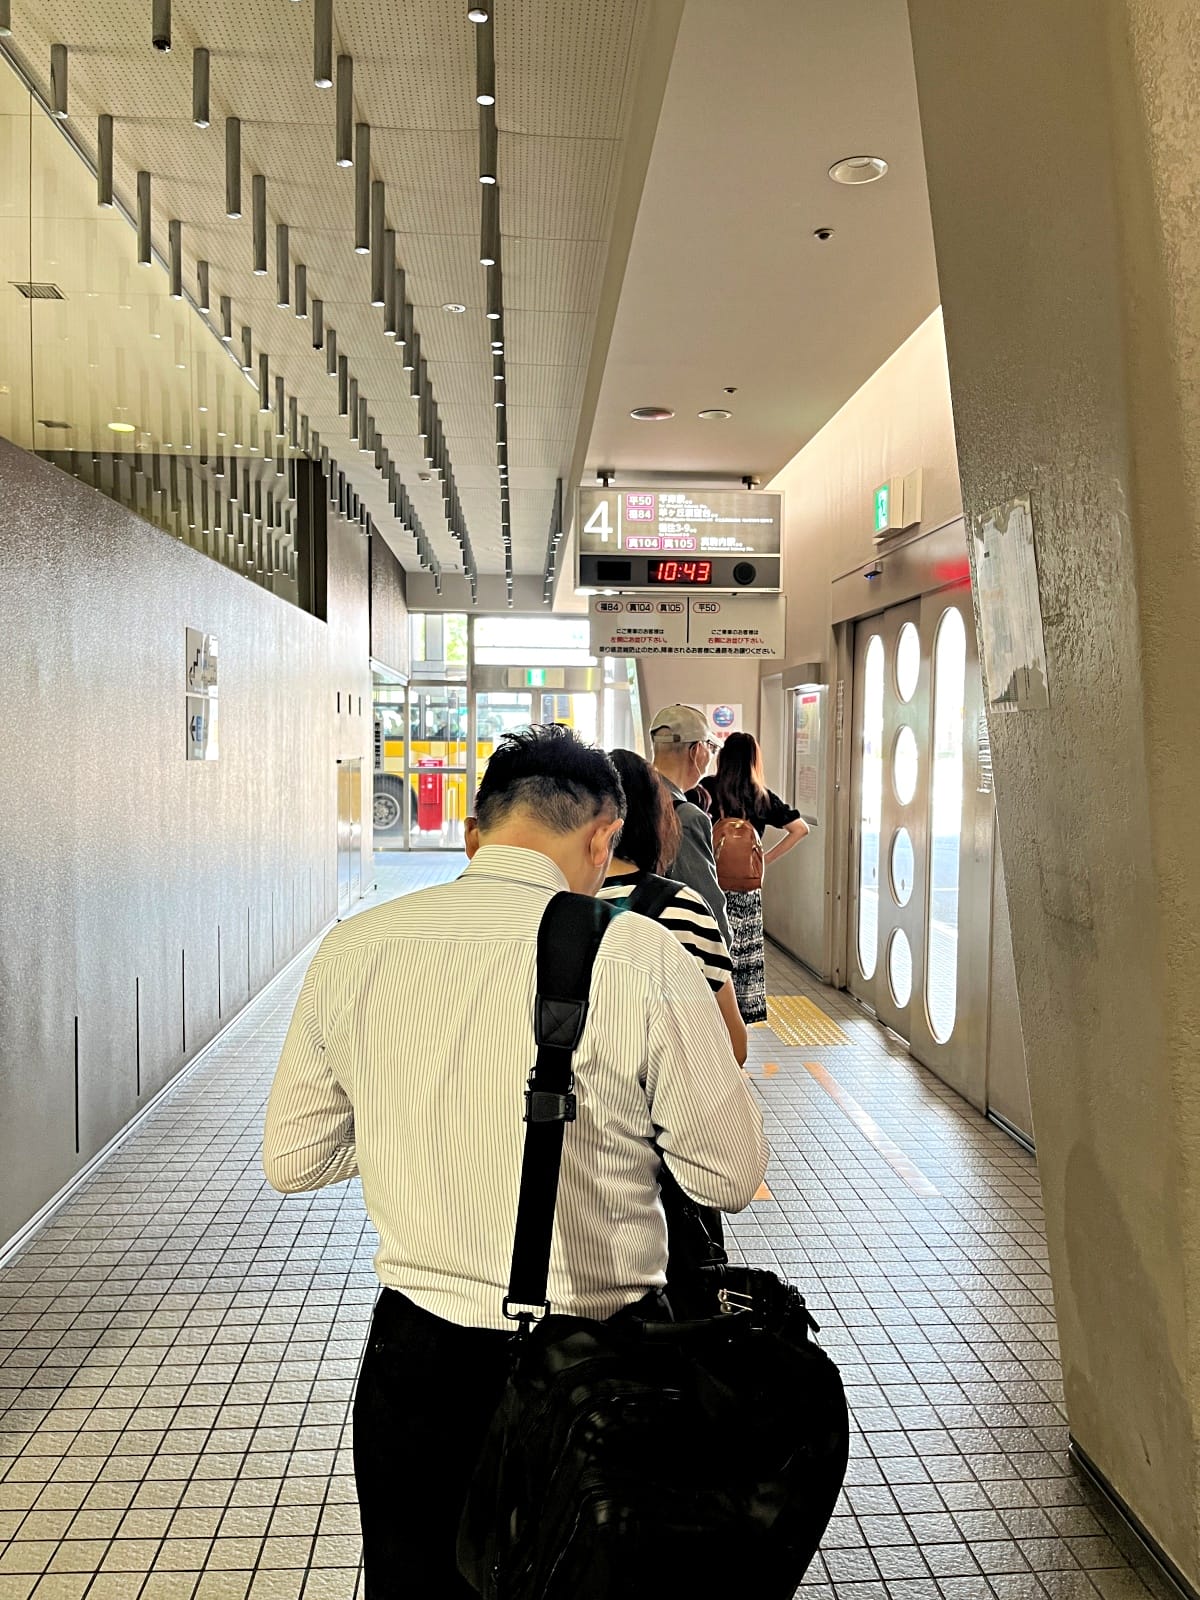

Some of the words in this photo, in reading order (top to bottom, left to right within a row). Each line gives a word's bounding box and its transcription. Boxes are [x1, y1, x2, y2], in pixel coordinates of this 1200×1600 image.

[629, 496, 652, 506] 平50
[629, 510, 651, 519] 福84
[584, 500, 613, 542] 4
[629, 538, 658, 548] 真104
[664, 539, 693, 549] 真105
[657, 562, 711, 582] 10:43
[600, 603, 619, 611] 福84
[629, 603, 650, 612] 真104
[660, 603, 681, 612] 真105
[698, 603, 717, 612] 平50
